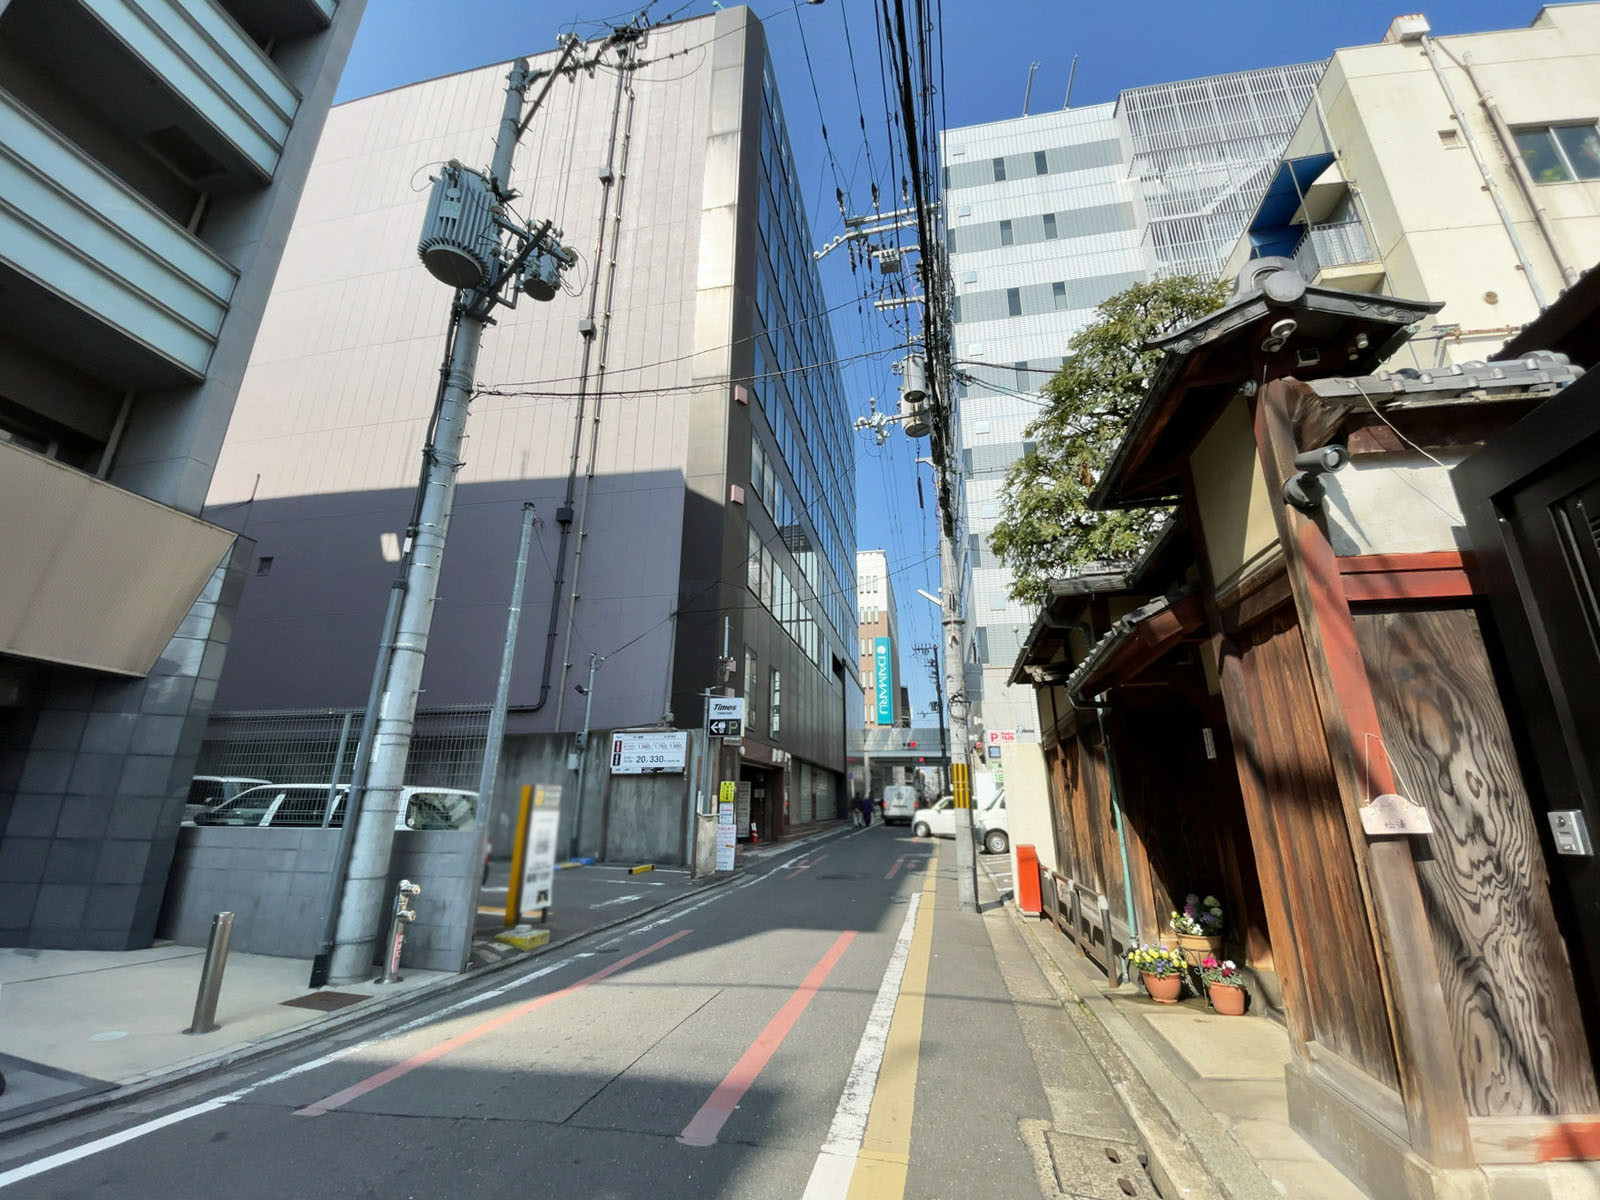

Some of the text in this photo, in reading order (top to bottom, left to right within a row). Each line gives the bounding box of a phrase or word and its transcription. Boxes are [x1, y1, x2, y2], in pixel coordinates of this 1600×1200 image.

[878, 655, 888, 715] DAIMARU
[713, 703, 737, 711] Times
[729, 721, 738, 735] P
[991, 732, 999, 742] P
